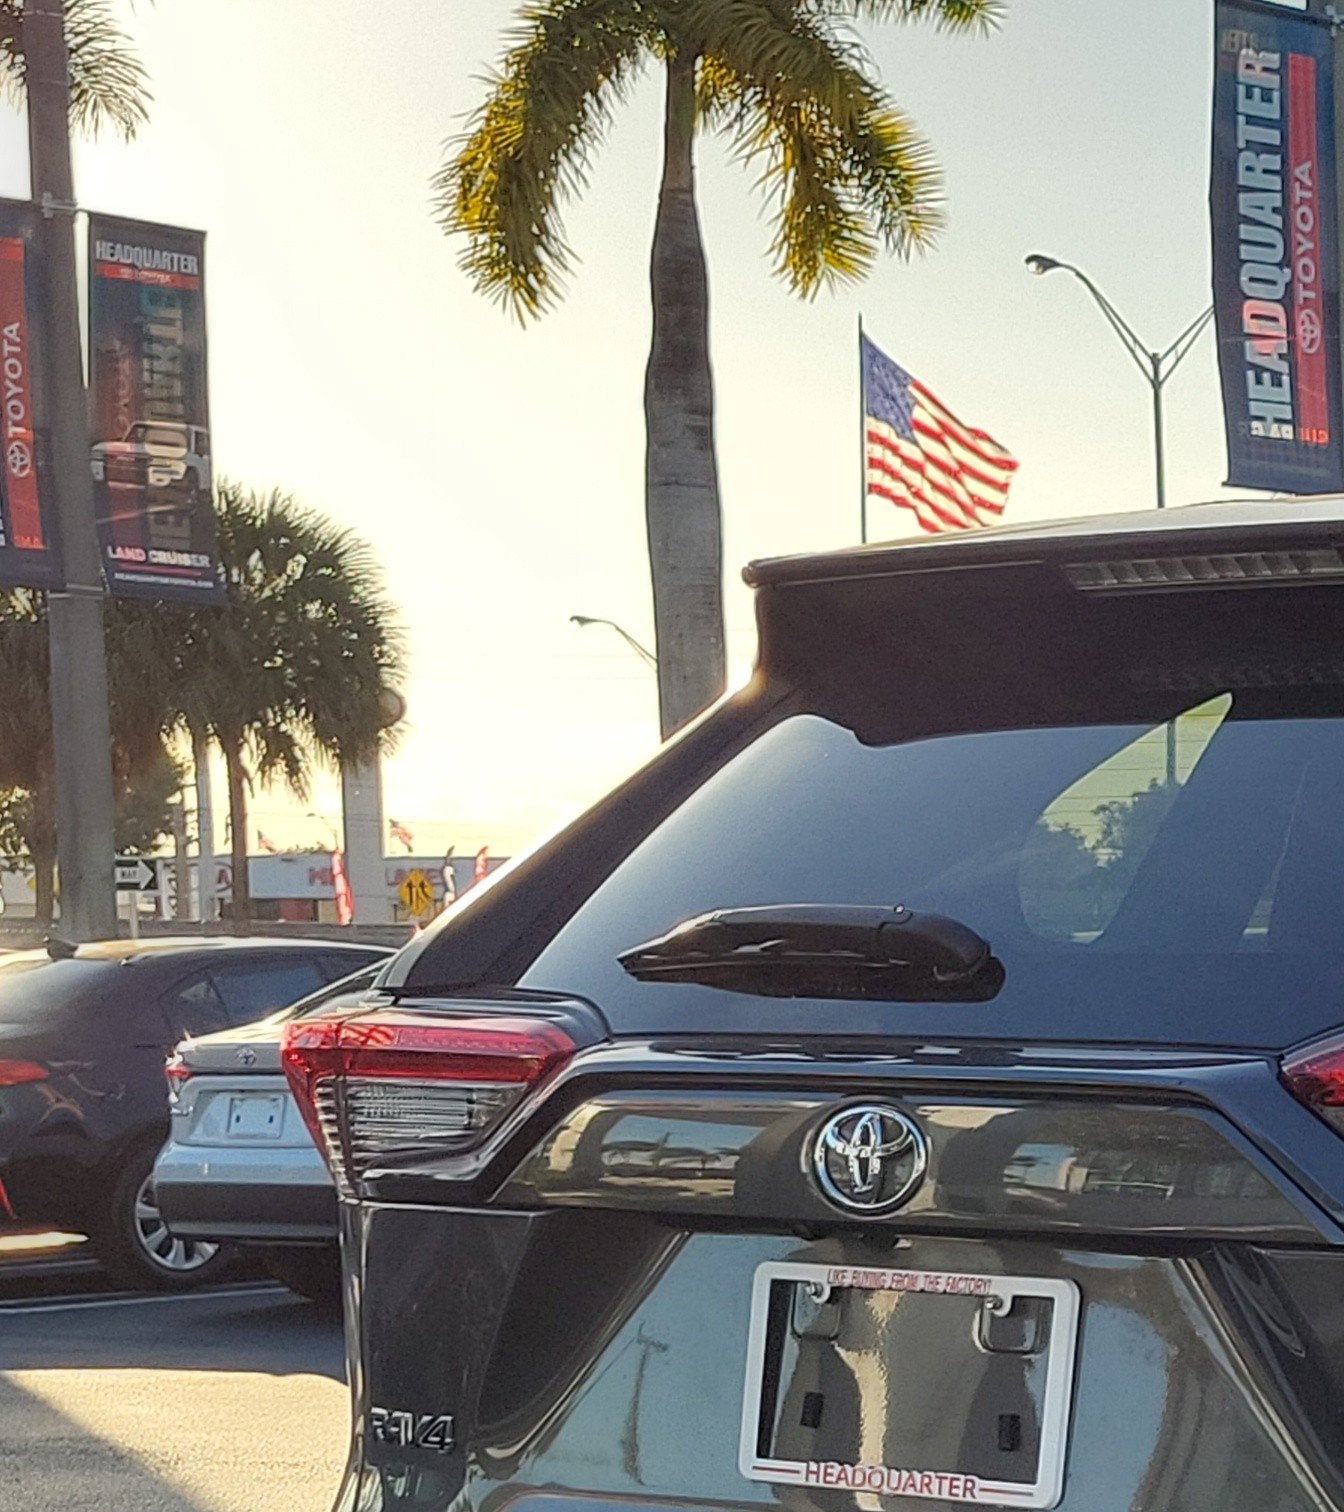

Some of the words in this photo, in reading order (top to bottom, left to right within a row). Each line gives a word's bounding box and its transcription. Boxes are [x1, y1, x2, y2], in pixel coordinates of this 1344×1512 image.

[1235, 47, 1294, 440] HEADQUARTER
[1294, 160, 1317, 305] TOYOTA
[95, 240, 199, 275] HEADQUARTER
[2, 321, 25, 438] TOYOTA
[107, 545, 146, 562] LAND
[148, 549, 211, 568] CRUISER
[828, 1269, 848, 1286] LIKE
[852, 1270, 887, 1289] BUYING
[891, 1272, 919, 1290] FROM
[924, 1274, 942, 1292] THE
[804, 1462, 977, 1498] HEADQUARTER
